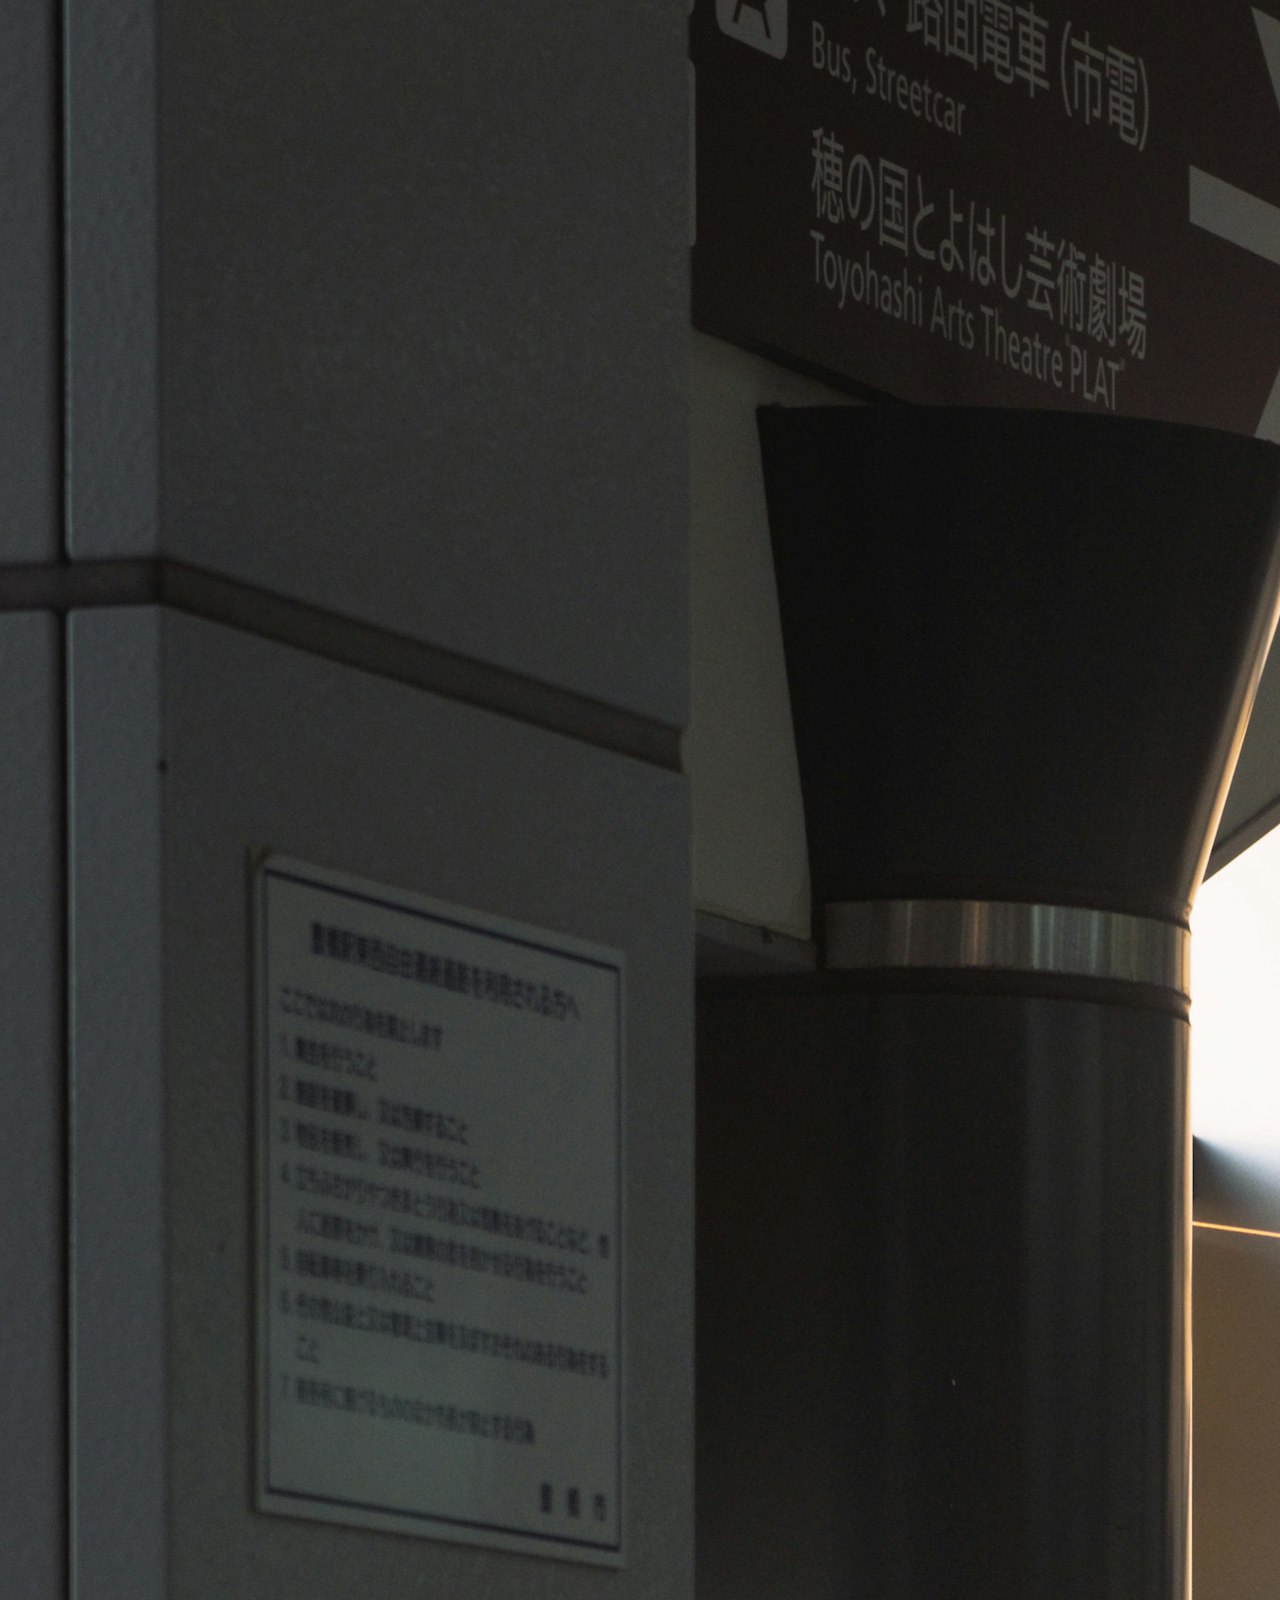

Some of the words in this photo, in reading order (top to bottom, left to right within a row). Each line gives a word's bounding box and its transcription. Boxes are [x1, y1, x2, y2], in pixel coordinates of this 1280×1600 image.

[812, 20, 857, 95] Bus,
[866, 46, 967, 137] Streetcar
[809, 229, 924, 328] Toyohashi
[930, 285, 975, 350] Arts
[980, 303, 1063, 389] Theatre
[810, 126, 1148, 361] 穂の国とよはし芸術劇場
